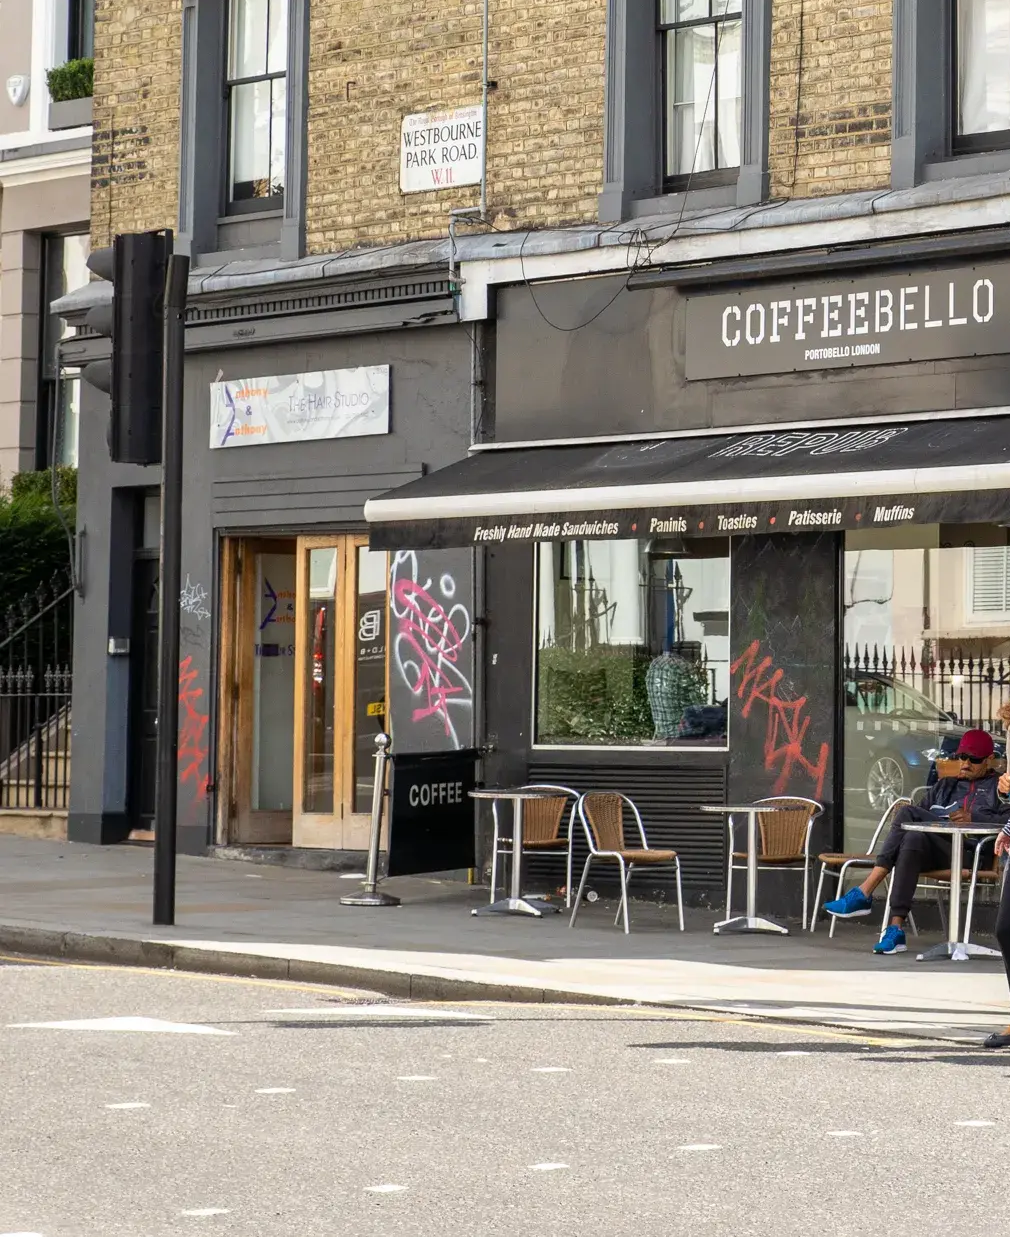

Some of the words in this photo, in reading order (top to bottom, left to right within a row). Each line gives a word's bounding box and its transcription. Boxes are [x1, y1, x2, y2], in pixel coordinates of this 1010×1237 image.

[403, 121, 482, 148] WESTBOURNE
[406, 148, 437, 168] PARK
[442, 143, 479, 163] ROAD.
[721, 278, 994, 347] COFFEEBELLO
[804, 346, 850, 361] PORTOBELLO
[851, 343, 881, 356] LONDON
[245, 405, 253, 416] &
[308, 393, 332, 411] HAIR
[334, 391, 370, 409] STUDIO
[717, 514, 758, 530] Toasties
[788, 508, 842, 526] Patisserie
[873, 505, 915, 522] Muffins
[474, 526, 506, 542] Freshly
[507, 523, 533, 539] Hand
[533, 522, 560, 538] Made
[561, 520, 619, 537] Sandwiches
[650, 517, 688, 533] Paninis
[409, 781, 463, 807] COFFEE
